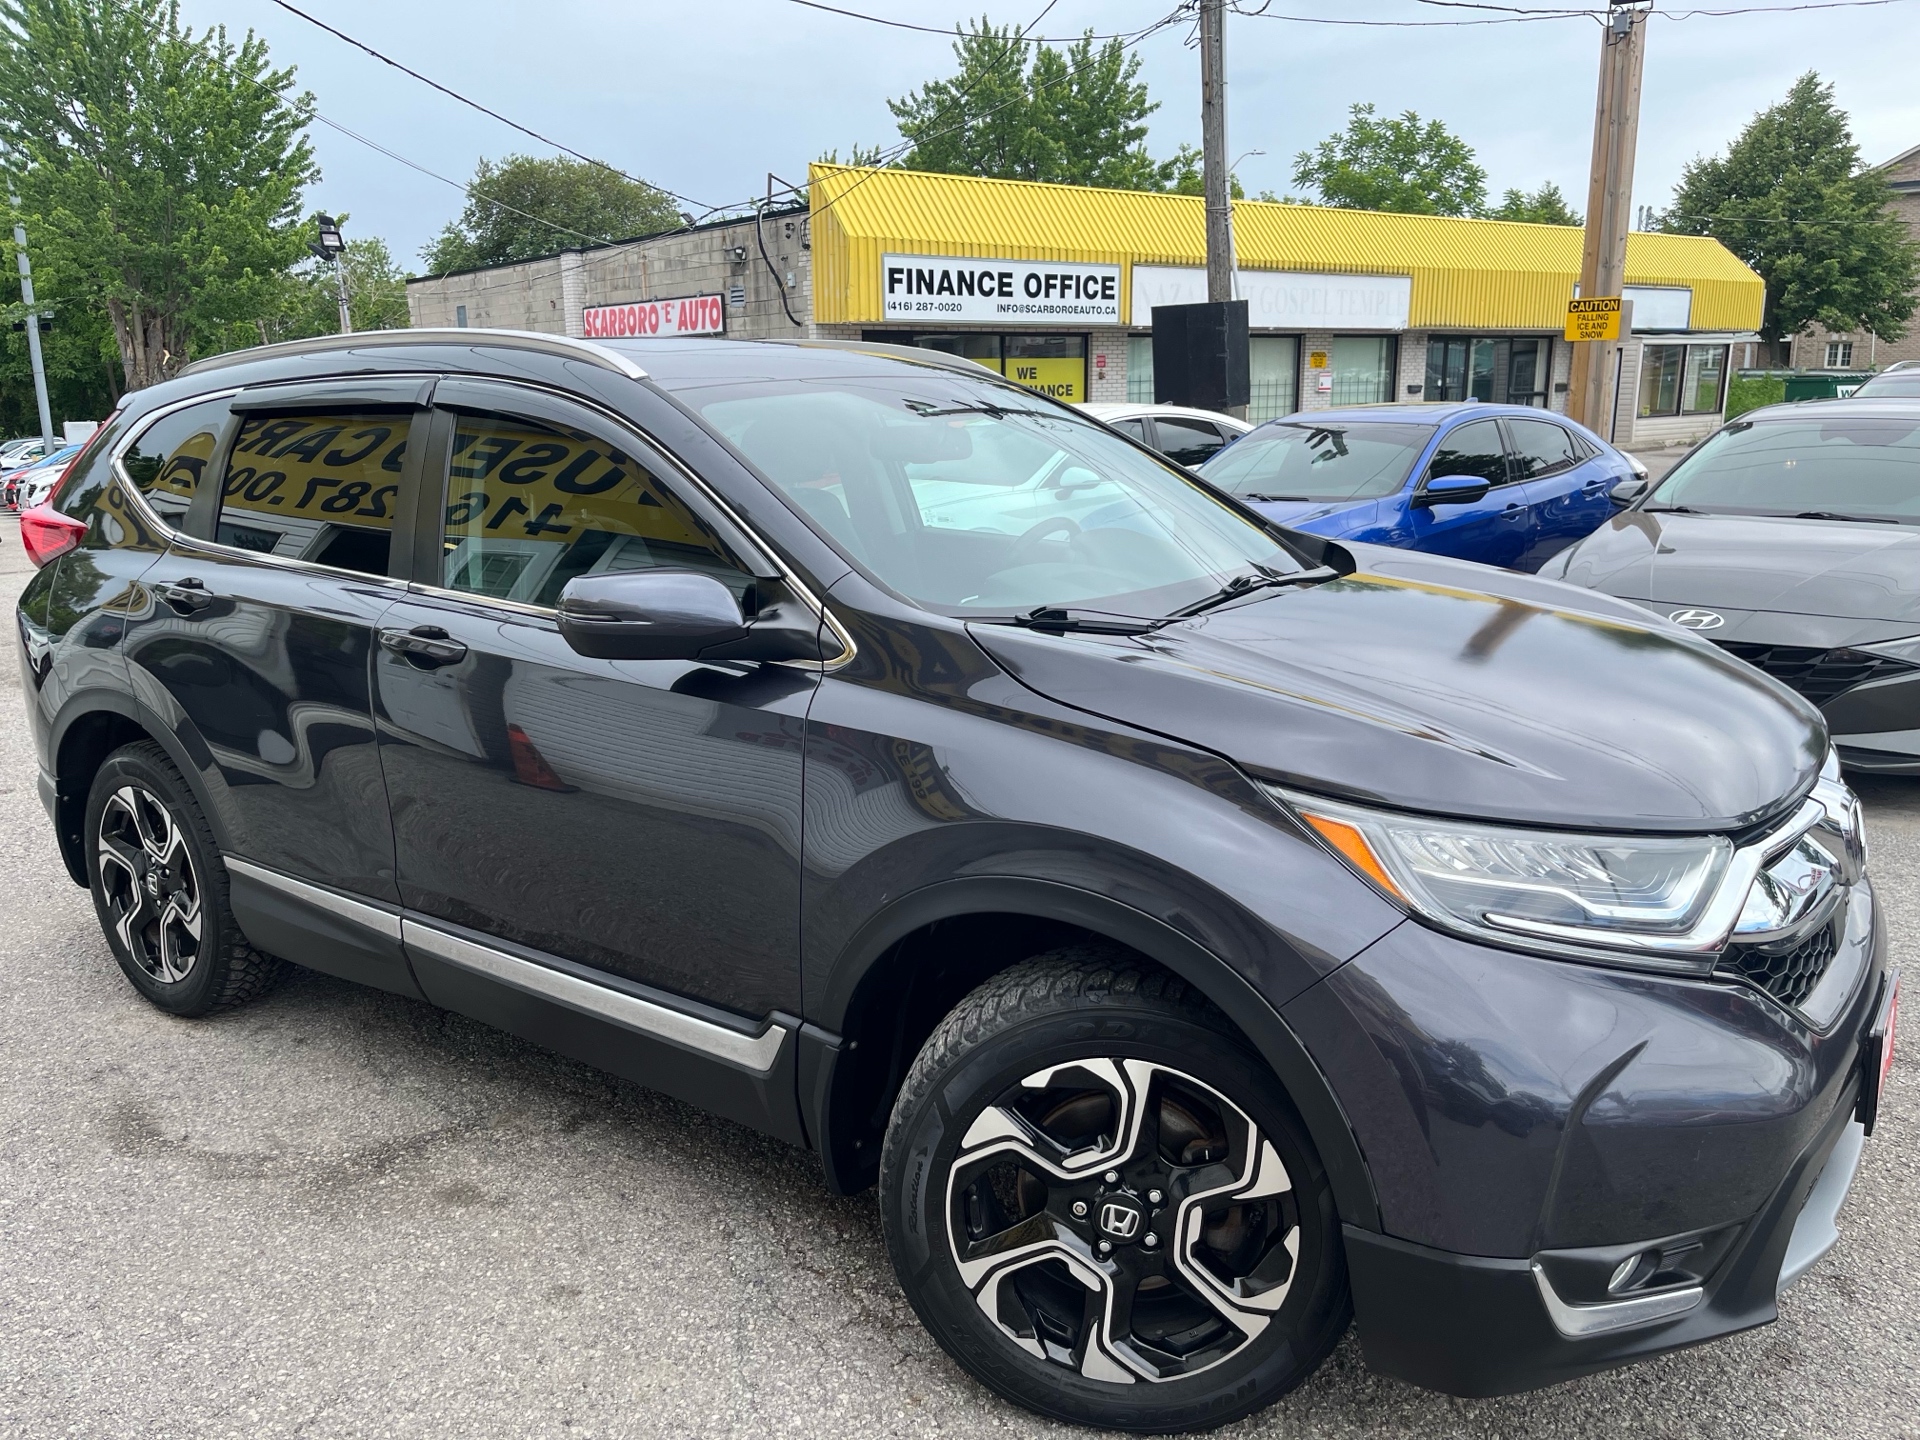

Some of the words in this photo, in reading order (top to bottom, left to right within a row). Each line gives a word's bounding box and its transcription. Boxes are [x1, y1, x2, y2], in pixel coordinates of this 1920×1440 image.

[888, 267, 1013, 298] FINANCE
[1024, 272, 1116, 300] OFFICE
[887, 301, 913, 312] (416)
[915, 302, 962, 313] 287-0020
[1260, 285, 1333, 314] GOSPEL
[1337, 288, 1406, 317] TEMPLE
[1570, 300, 1618, 312] CAUTION
[997, 303, 1116, 316] INFO@SCARBOROEAUTO.CA
[585, 304, 659, 337] SCARBORO
[677, 297, 721, 331] AUTO
[1577, 313, 1609, 322] FALLING
[1577, 322, 1590, 330] ICE
[1591, 322, 1608, 330] AND
[1579, 331, 1603, 339] SNOW
[1016, 367, 1037, 380] WE
[1028, 384, 1073, 396] NANCE
[908, 1160, 924, 1235] Rotation
